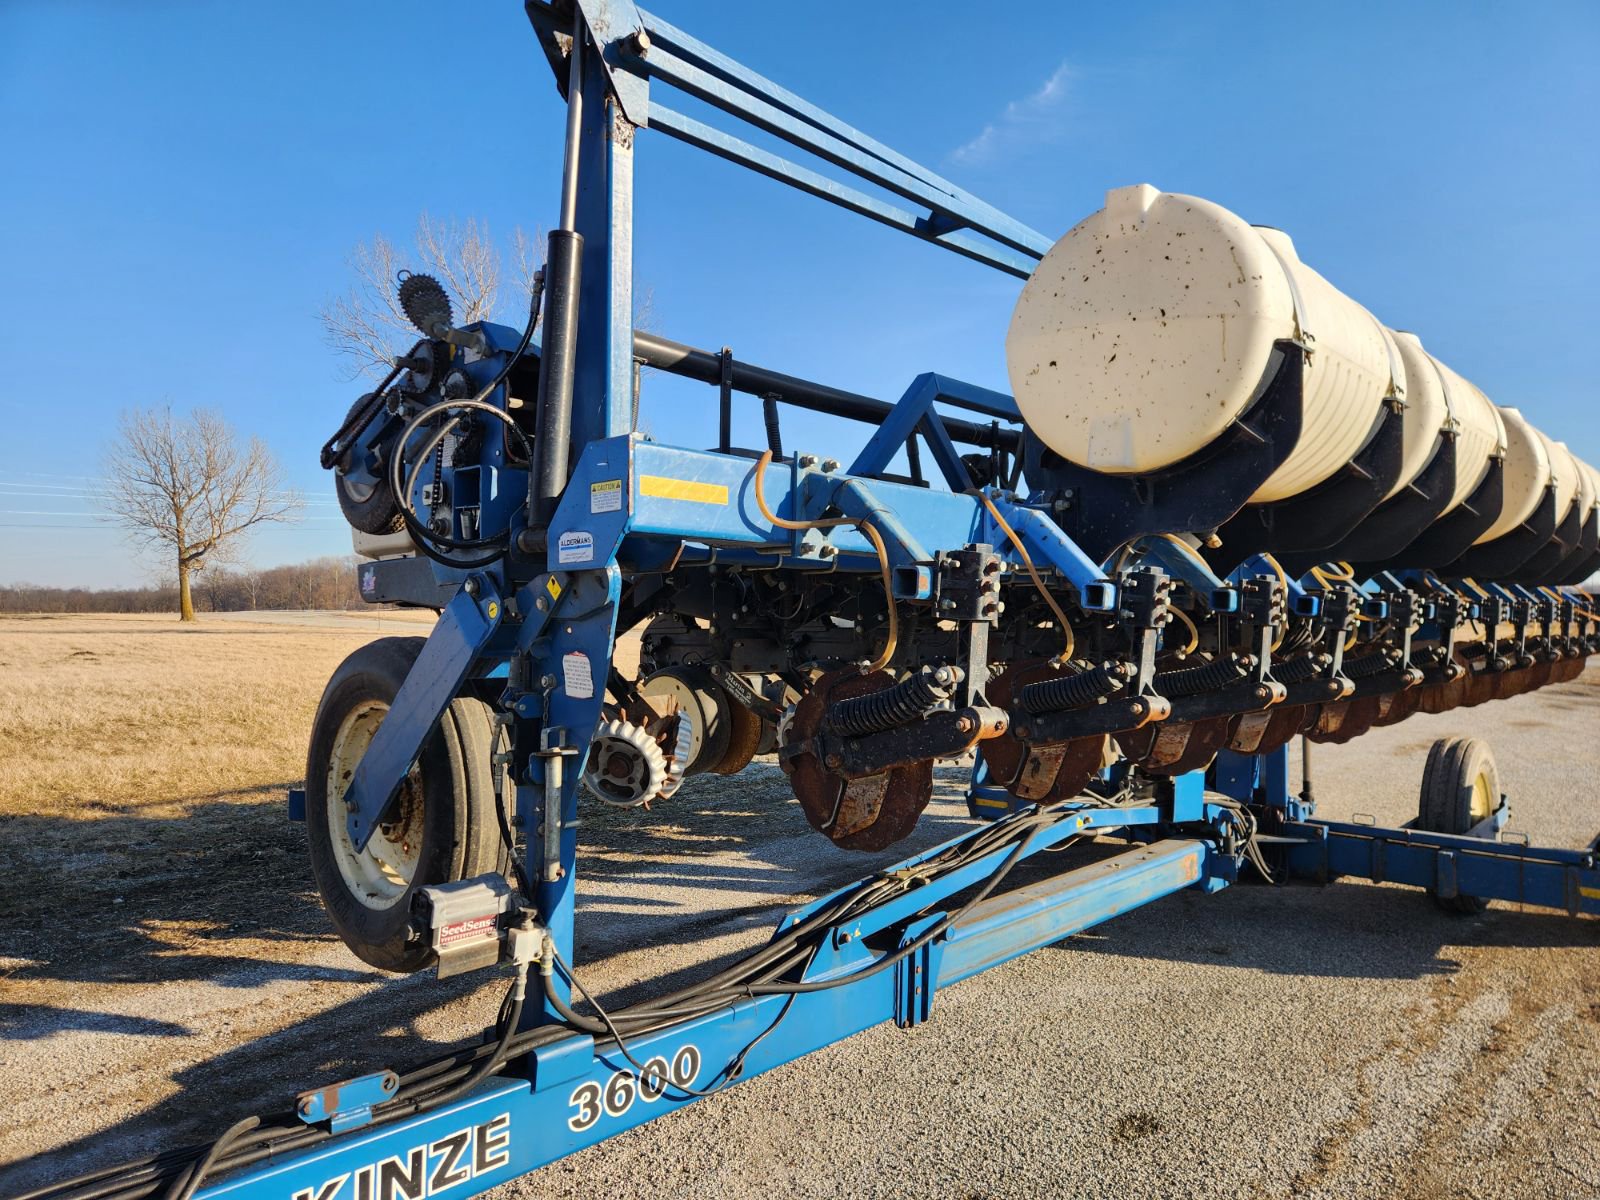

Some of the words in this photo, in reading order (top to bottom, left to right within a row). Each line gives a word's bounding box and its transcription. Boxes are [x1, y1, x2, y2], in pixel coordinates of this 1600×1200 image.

[441, 918, 496, 937] SeedSense
[292, 1112, 510, 1200] INZE
[568, 1045, 701, 1132] 3600
